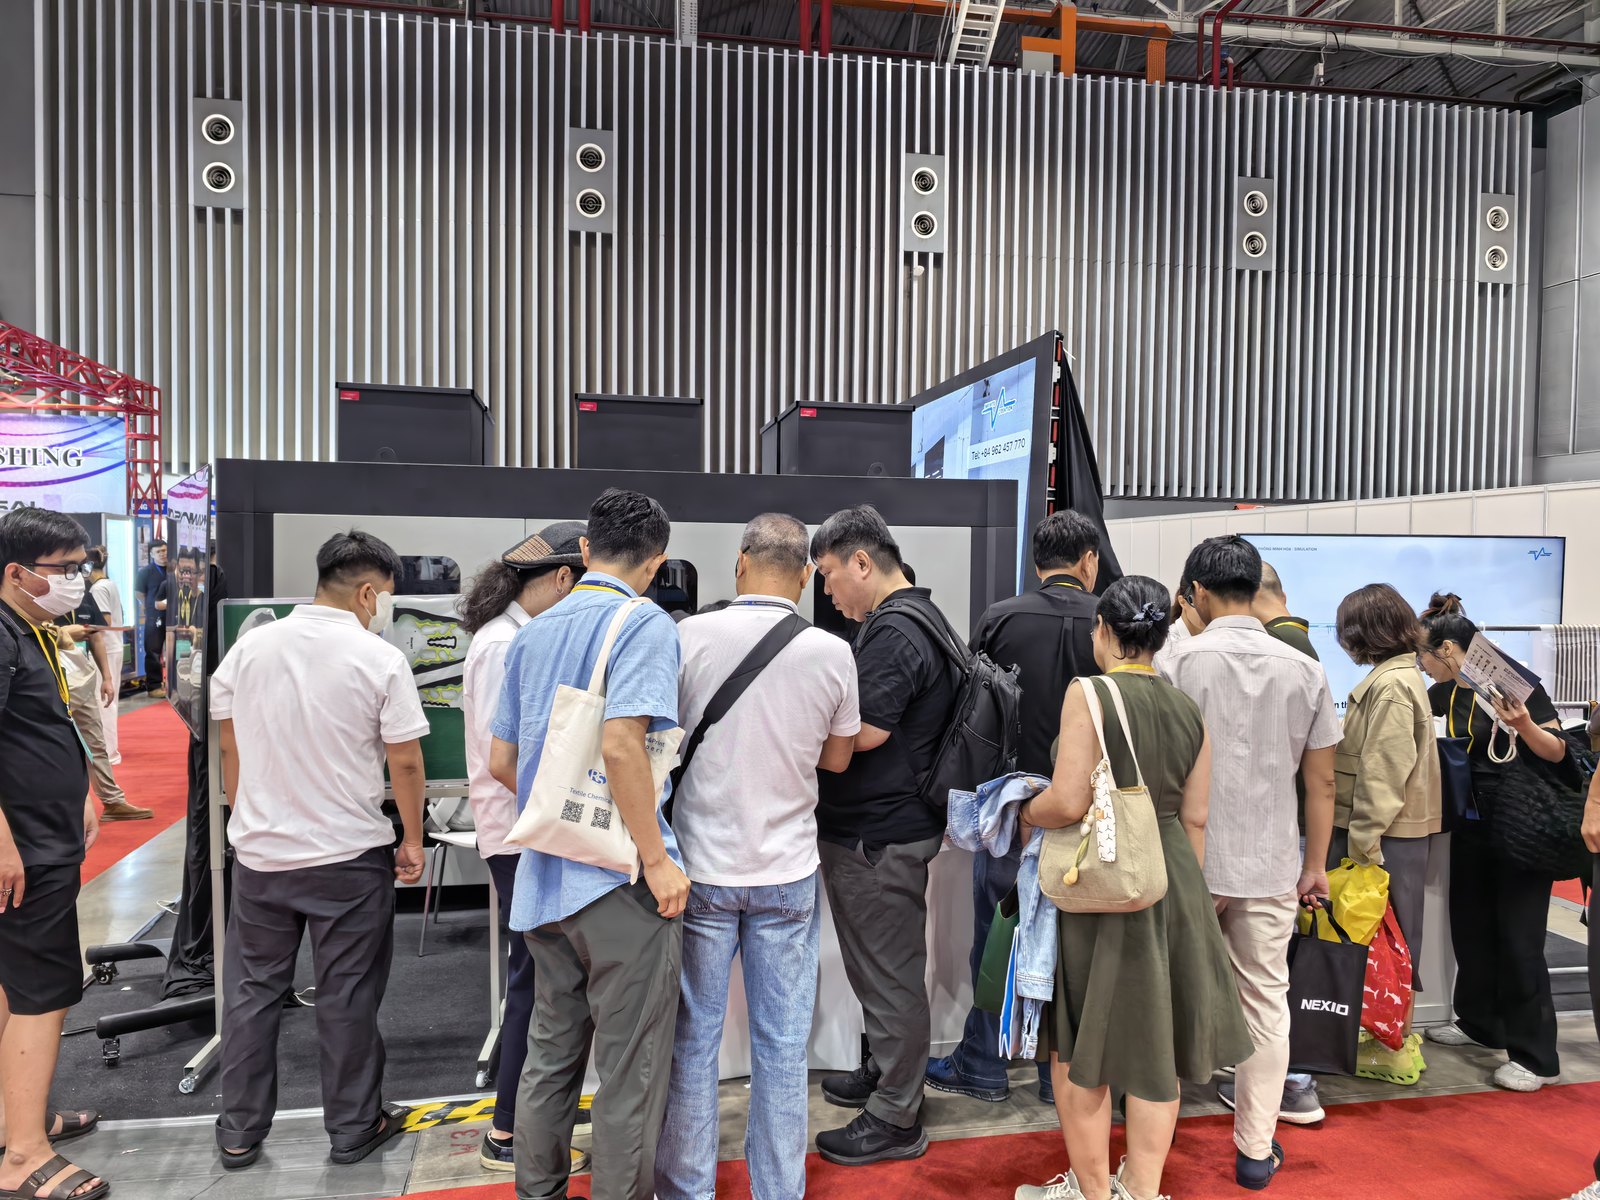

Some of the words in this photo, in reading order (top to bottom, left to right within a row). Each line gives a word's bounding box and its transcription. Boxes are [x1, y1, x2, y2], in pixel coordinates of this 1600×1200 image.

[981, 448, 991, 458] +84
[991, 444, 1002, 456] 962
[1002, 441, 1013, 453] 457
[1014, 437, 1026, 450] 770
[569, 787, 587, 798] Textile
[1300, 998, 1349, 1016] NEXIO
